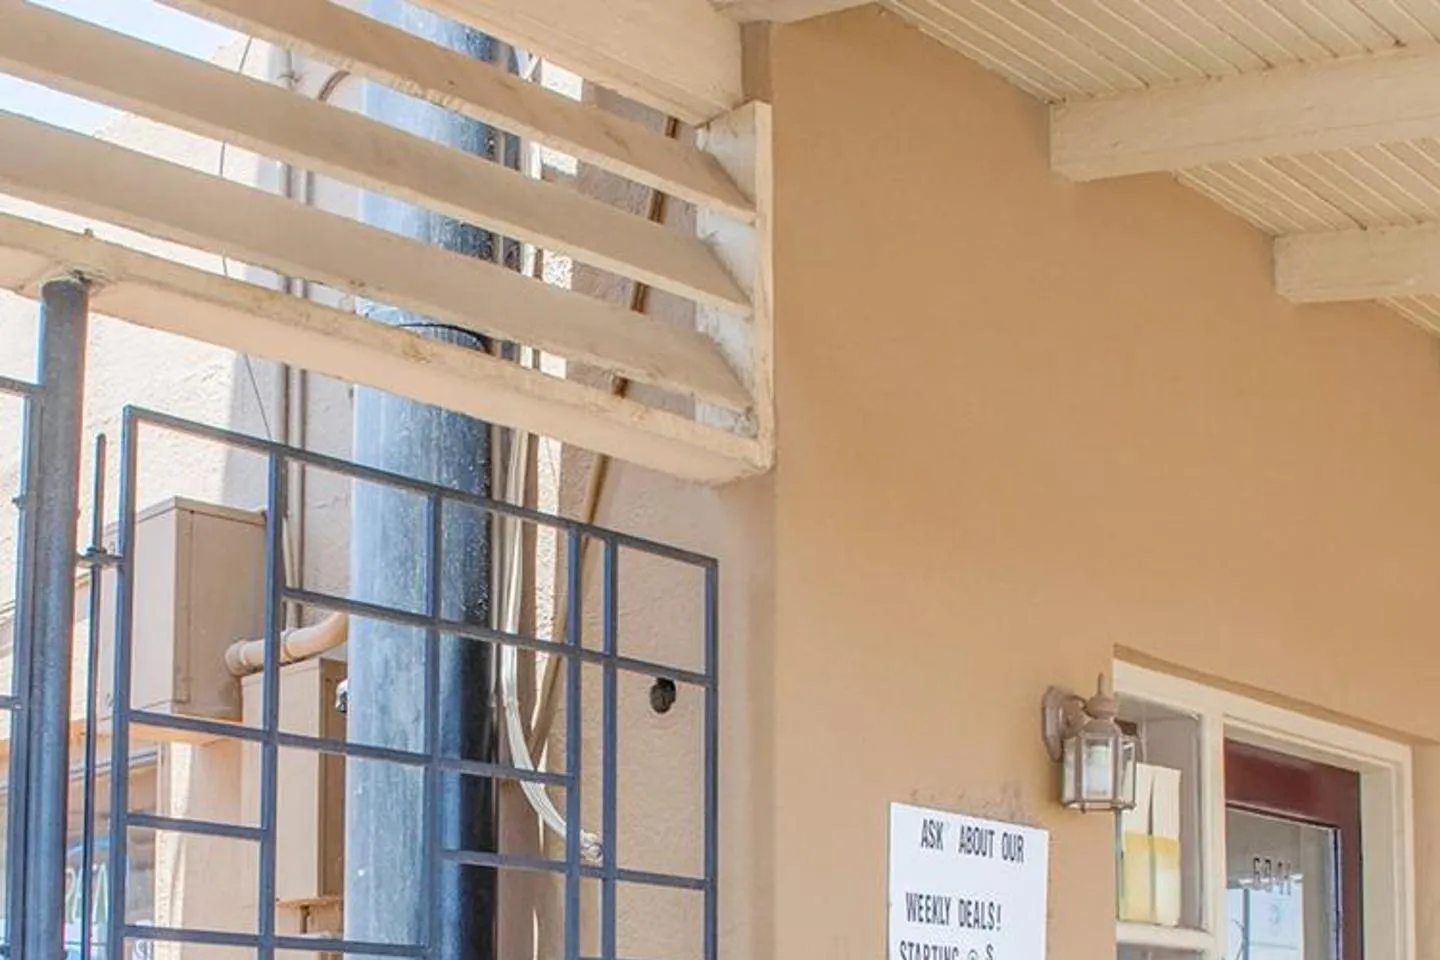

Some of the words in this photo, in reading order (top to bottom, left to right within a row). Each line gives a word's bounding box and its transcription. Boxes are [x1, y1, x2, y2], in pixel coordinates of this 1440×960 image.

[921, 818, 943, 851] ASK
[958, 824, 995, 858] ABOUT
[1002, 831, 1024, 863] OUR
[906, 892, 951, 926] WEEKLY
[958, 899, 1001, 931] DEALS!
